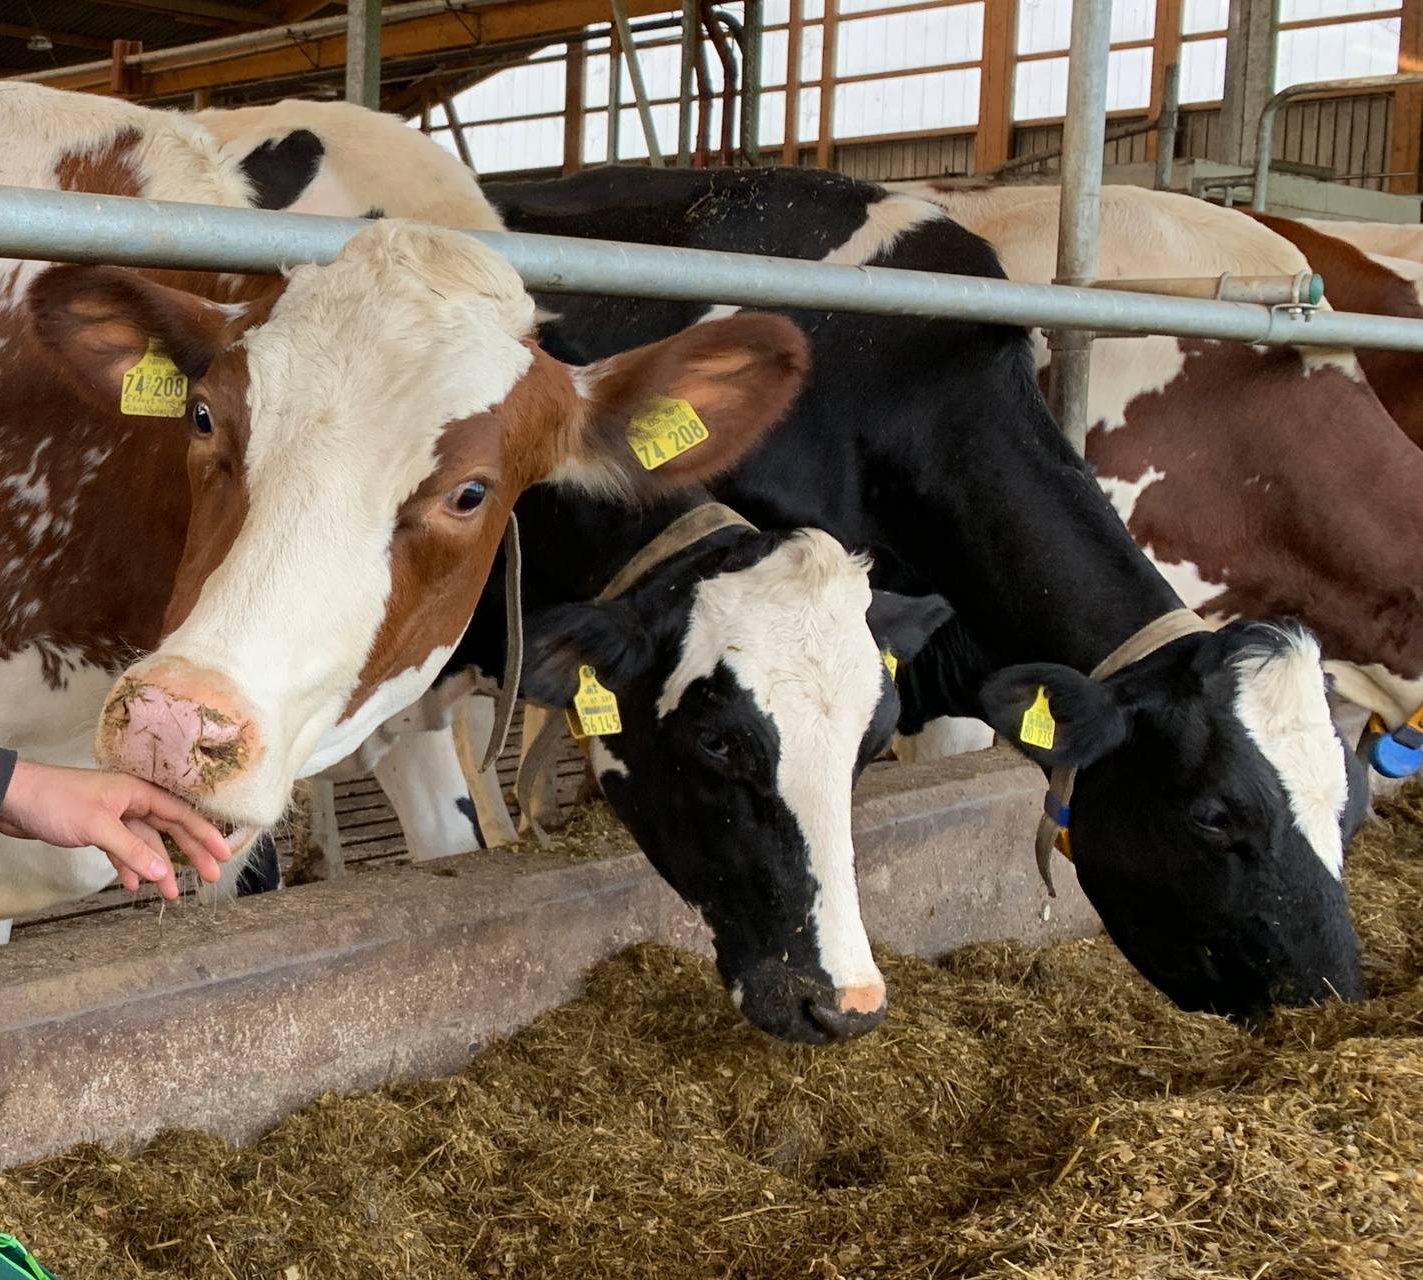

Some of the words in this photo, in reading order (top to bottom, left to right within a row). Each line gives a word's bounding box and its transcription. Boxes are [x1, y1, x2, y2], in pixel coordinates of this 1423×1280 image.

[124, 374, 144, 396] 74
[153, 376, 184, 397] 208
[637, 441, 666, 468] 74
[668, 419, 705, 452] 208
